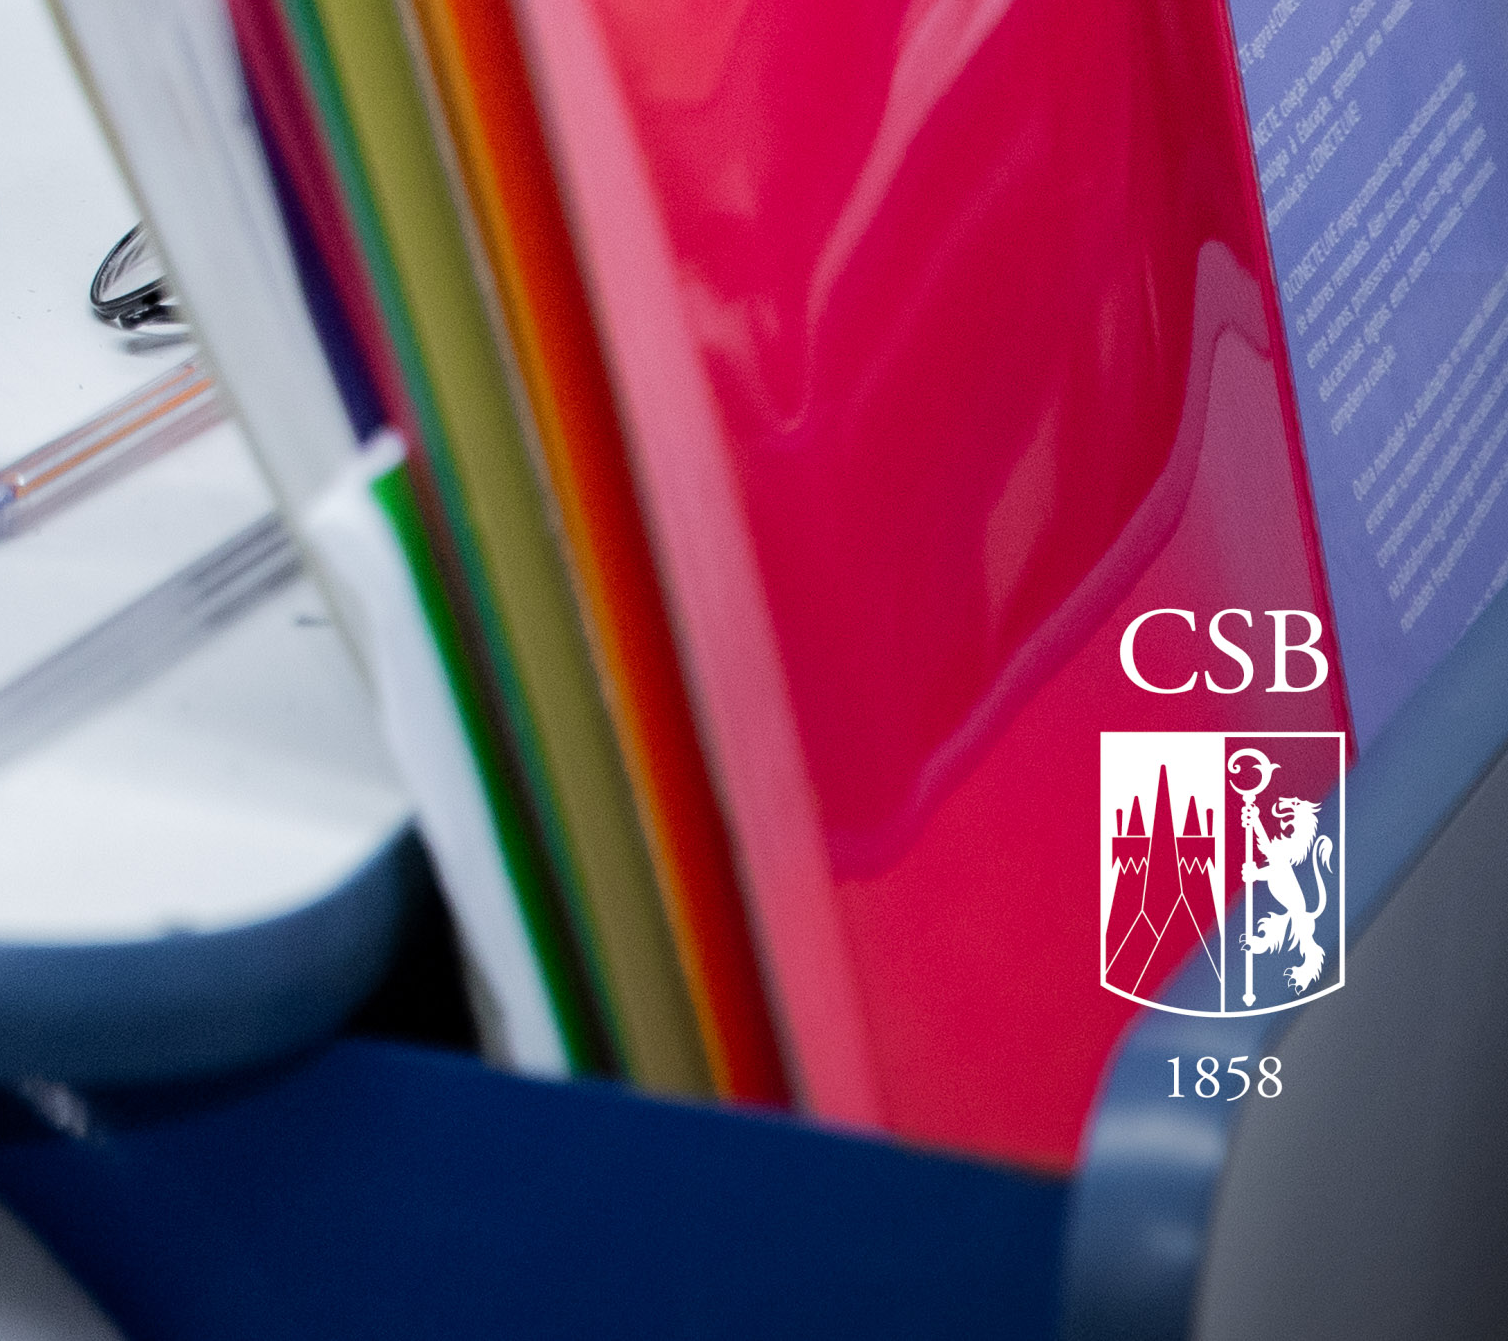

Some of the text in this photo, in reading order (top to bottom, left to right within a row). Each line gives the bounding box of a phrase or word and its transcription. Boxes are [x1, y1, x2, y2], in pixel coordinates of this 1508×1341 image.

[1247, 105, 1283, 162] NECTE,
[1309, 120, 1345, 172] CONECTE
[1281, 280, 1293, 303] O
[1288, 240, 1325, 294] CONECTE
[1318, 220, 1340, 256] LIVE
[1295, 313, 1308, 336] de
[1305, 280, 1334, 323] autores
[1306, 335, 1329, 369] entre
[1350, 252, 1391, 317] professores
[1318, 336, 1365, 402] educacionais
[1330, 383, 1366, 435] compõem
[1352, 465, 1376, 501] Outra
